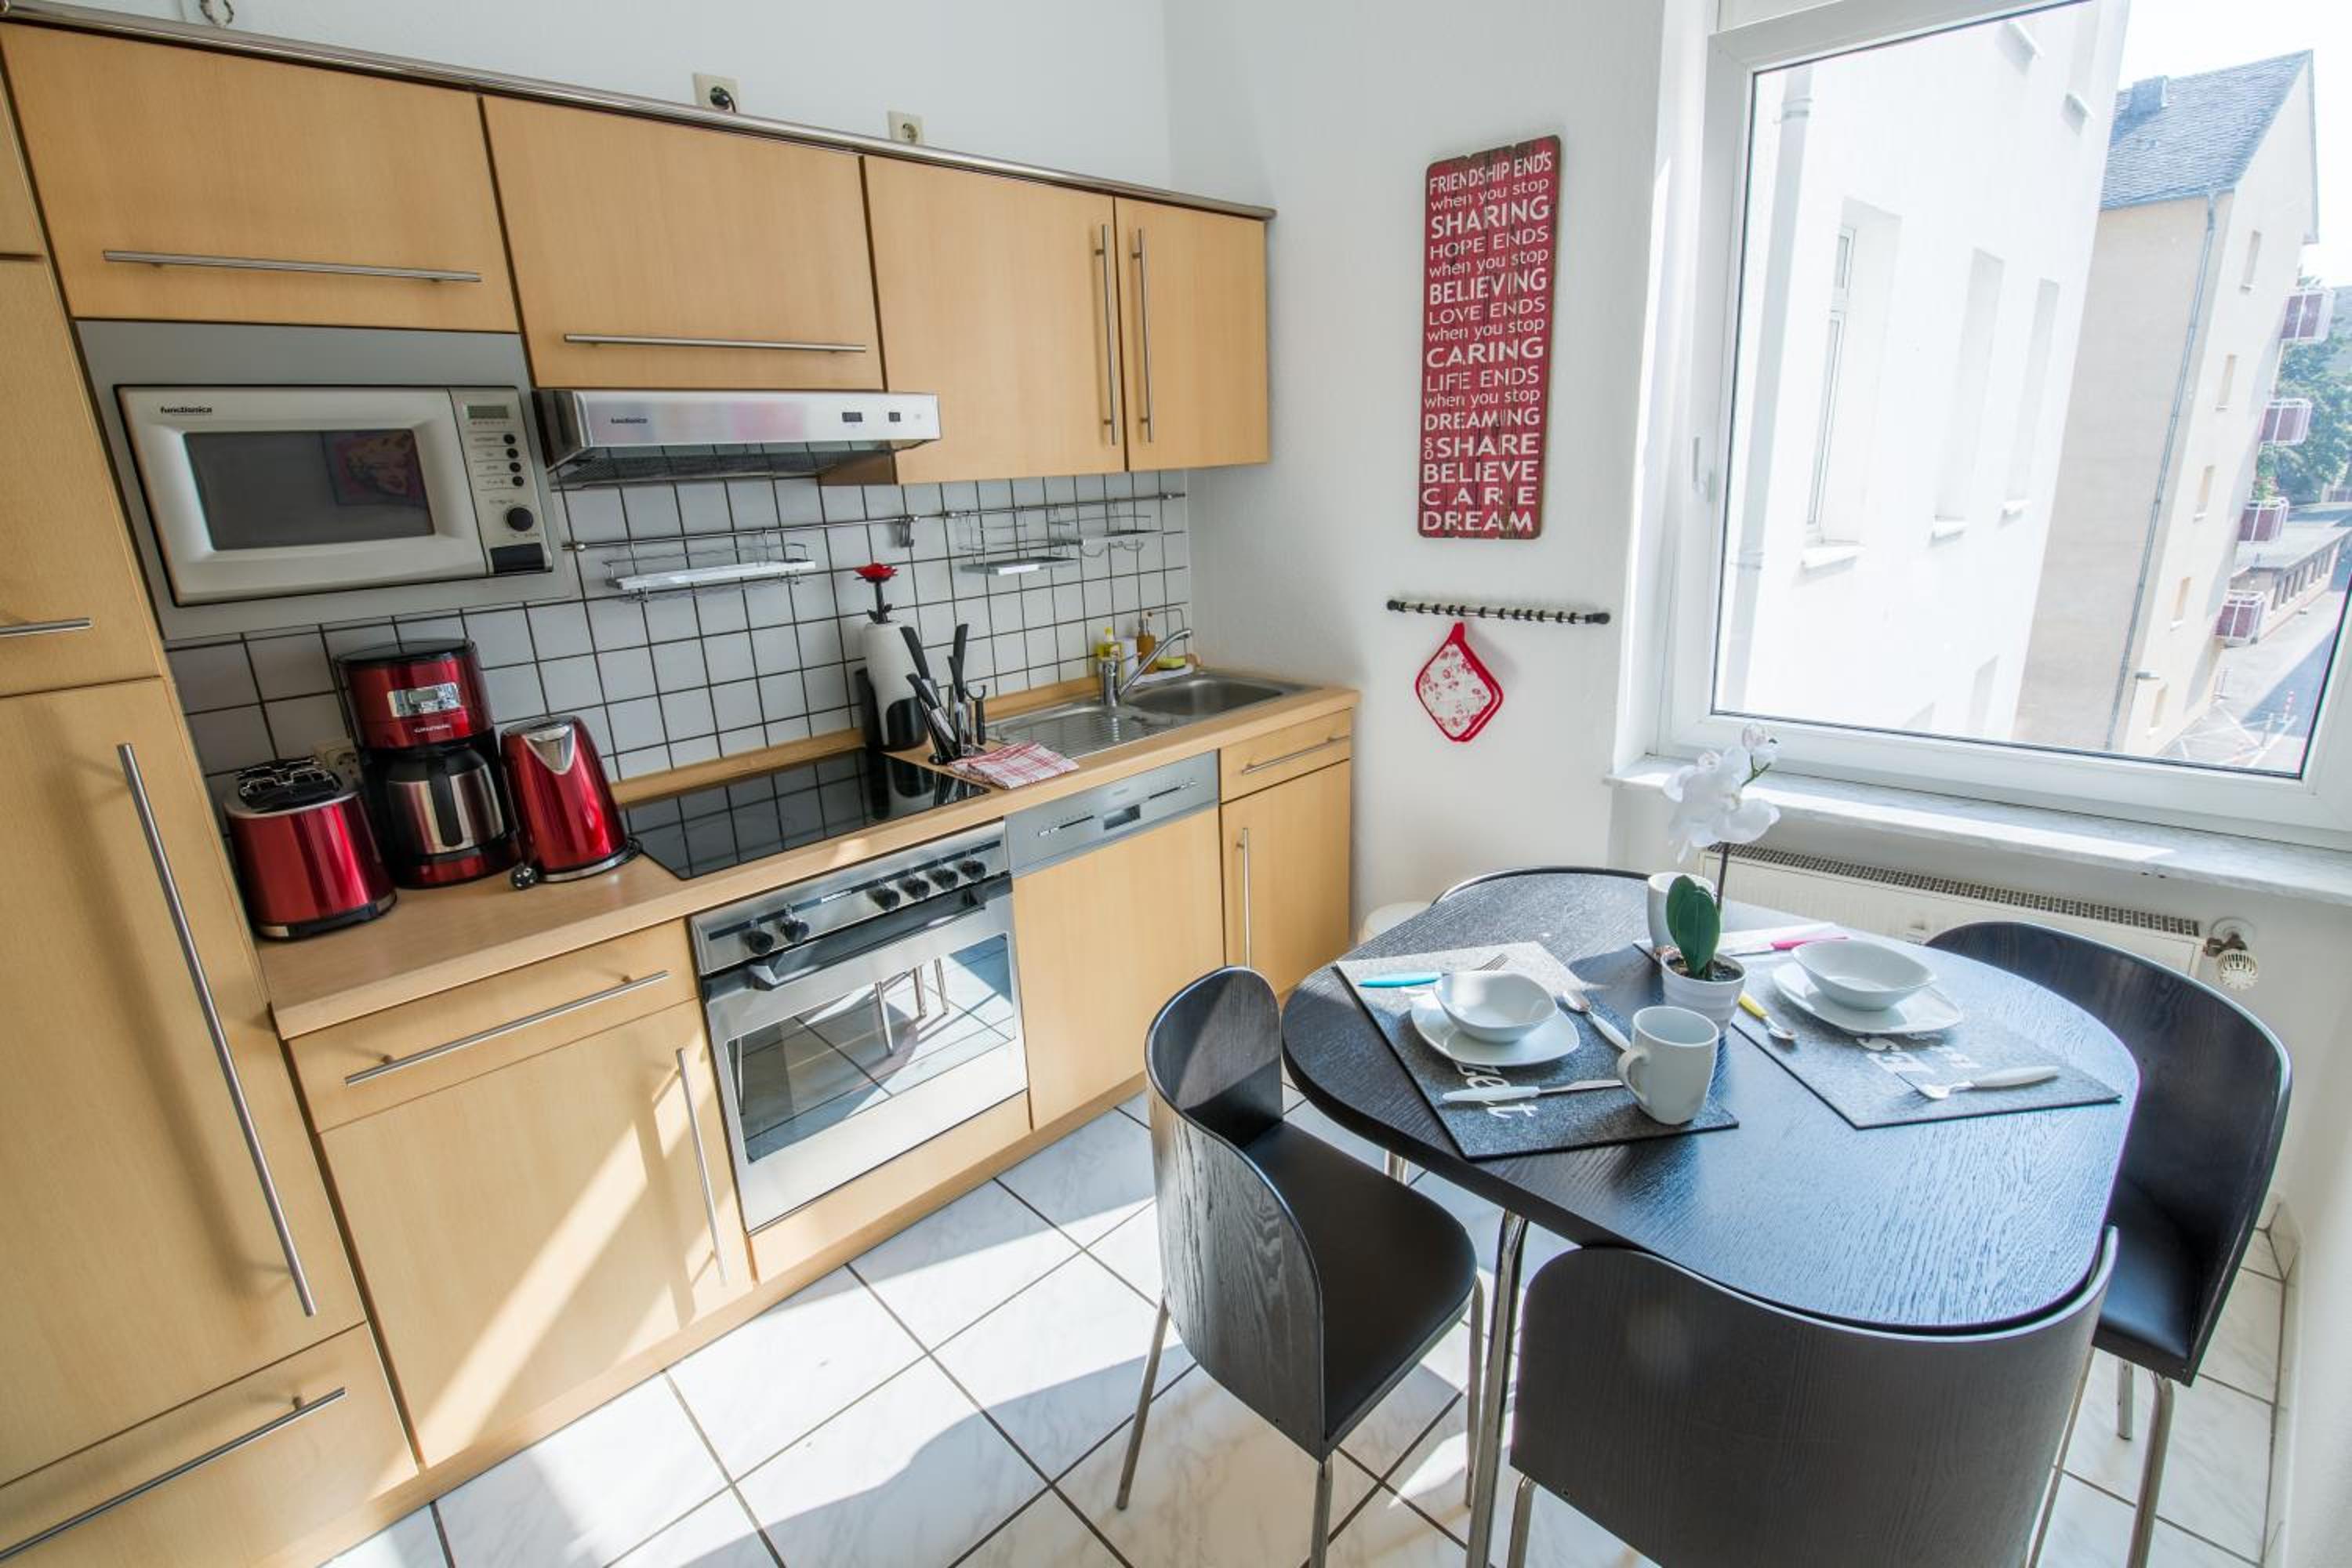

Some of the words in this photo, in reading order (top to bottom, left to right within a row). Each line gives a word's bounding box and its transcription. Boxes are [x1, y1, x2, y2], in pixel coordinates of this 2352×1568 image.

[1429, 162, 1510, 195] FRIENDSHIP
[1513, 151, 1552, 177] ENDS
[1431, 193, 1472, 211] when
[1478, 186, 1506, 205] you
[1512, 178, 1548, 195] stop
[1430, 195, 1549, 239] SHARING
[1430, 236, 1486, 260] HOPE
[1493, 226, 1548, 250] ENDS
[1429, 260, 1470, 278] when
[1476, 255, 1505, 274] you
[1511, 248, 1548, 266] stop
[1429, 267, 1547, 305] BELIEVING
[1429, 305, 1481, 325] LOVE
[1490, 296, 1545, 318] ENDS
[1427, 328, 1468, 343] when
[1475, 324, 1503, 341] you
[1508, 318, 1544, 334] stop
[1426, 336, 1544, 368] CARING
[1426, 372, 1471, 392] LIFE
[1480, 365, 1539, 387] ENDS
[1425, 394, 1465, 408] when
[1471, 392, 1498, 408] you
[1504, 389, 1540, 405] stop
[1425, 407, 1541, 431] DREAMING
[1436, 433, 1539, 458] SHARE
[1423, 460, 1538, 484] BELIEVE
[1422, 486, 1537, 506] CARE
[1422, 510, 1534, 532] DREAM
